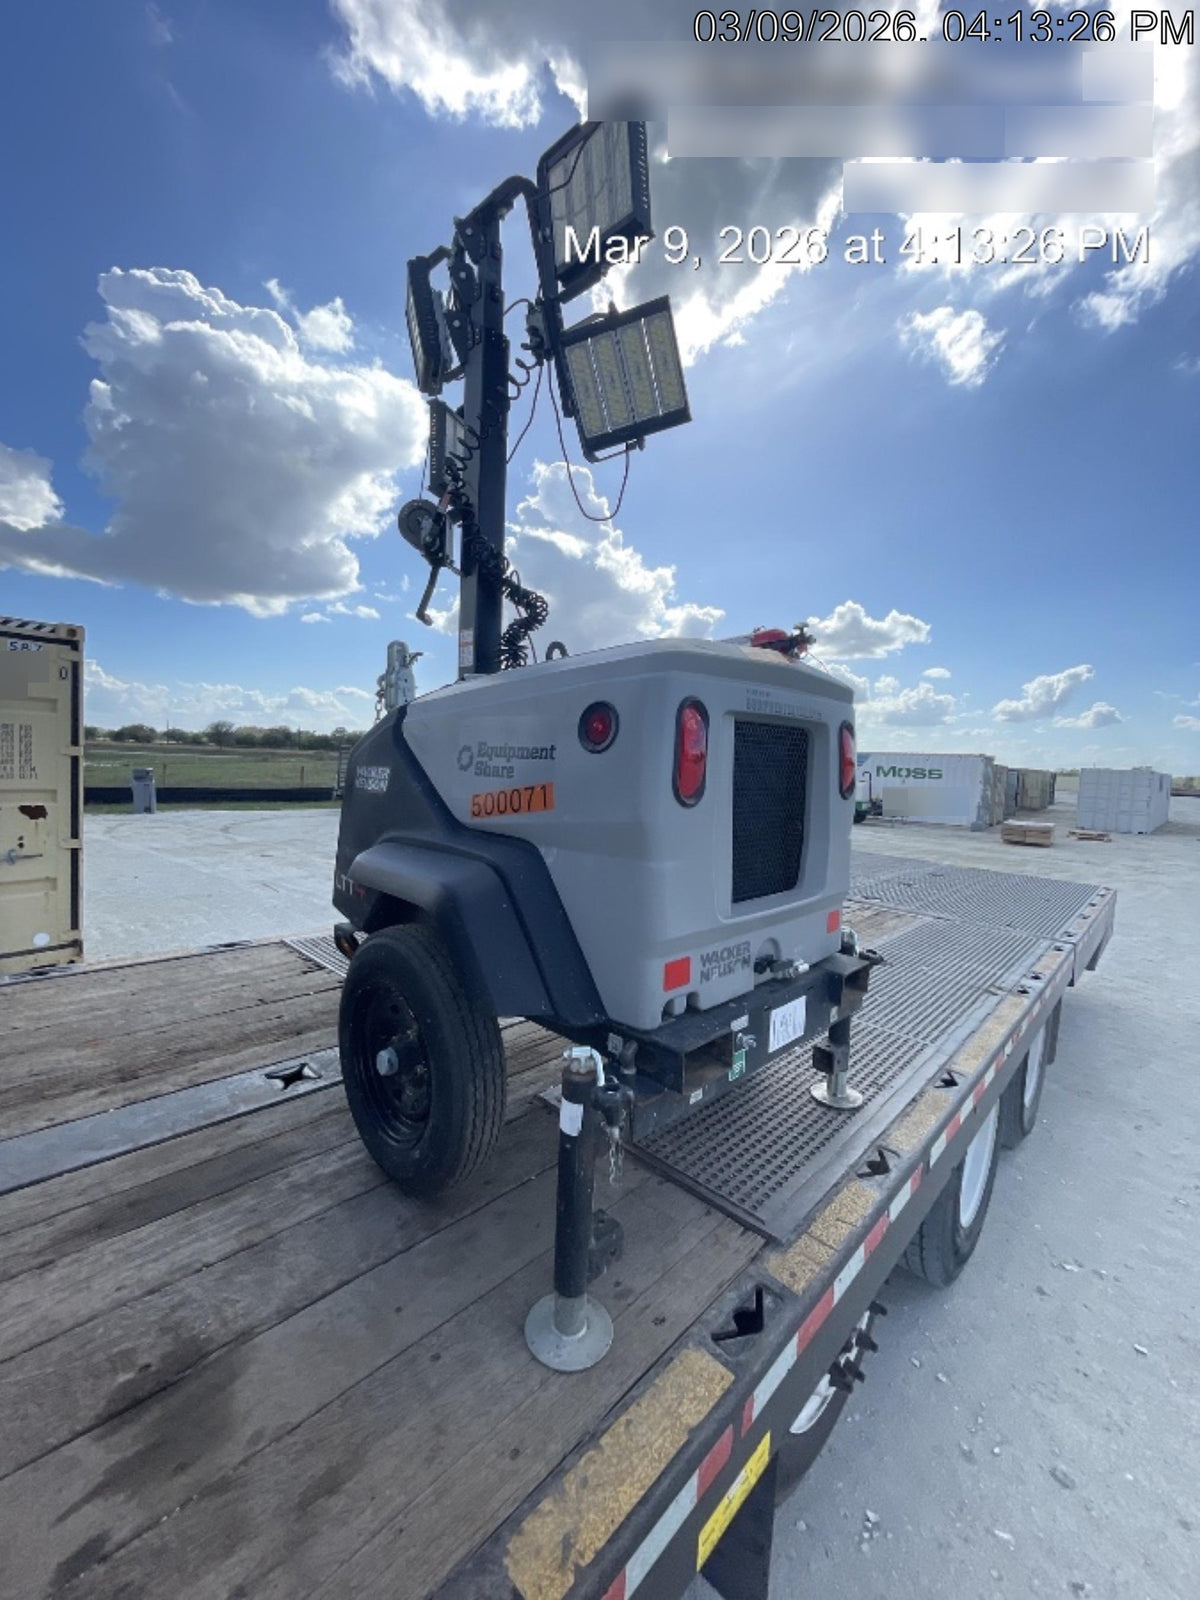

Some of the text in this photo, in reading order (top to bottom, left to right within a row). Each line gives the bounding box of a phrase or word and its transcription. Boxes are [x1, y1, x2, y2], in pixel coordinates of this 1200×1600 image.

[477, 741, 557, 762] Equipment
[474, 761, 515, 779] Share
[472, 784, 548, 818] 500071
